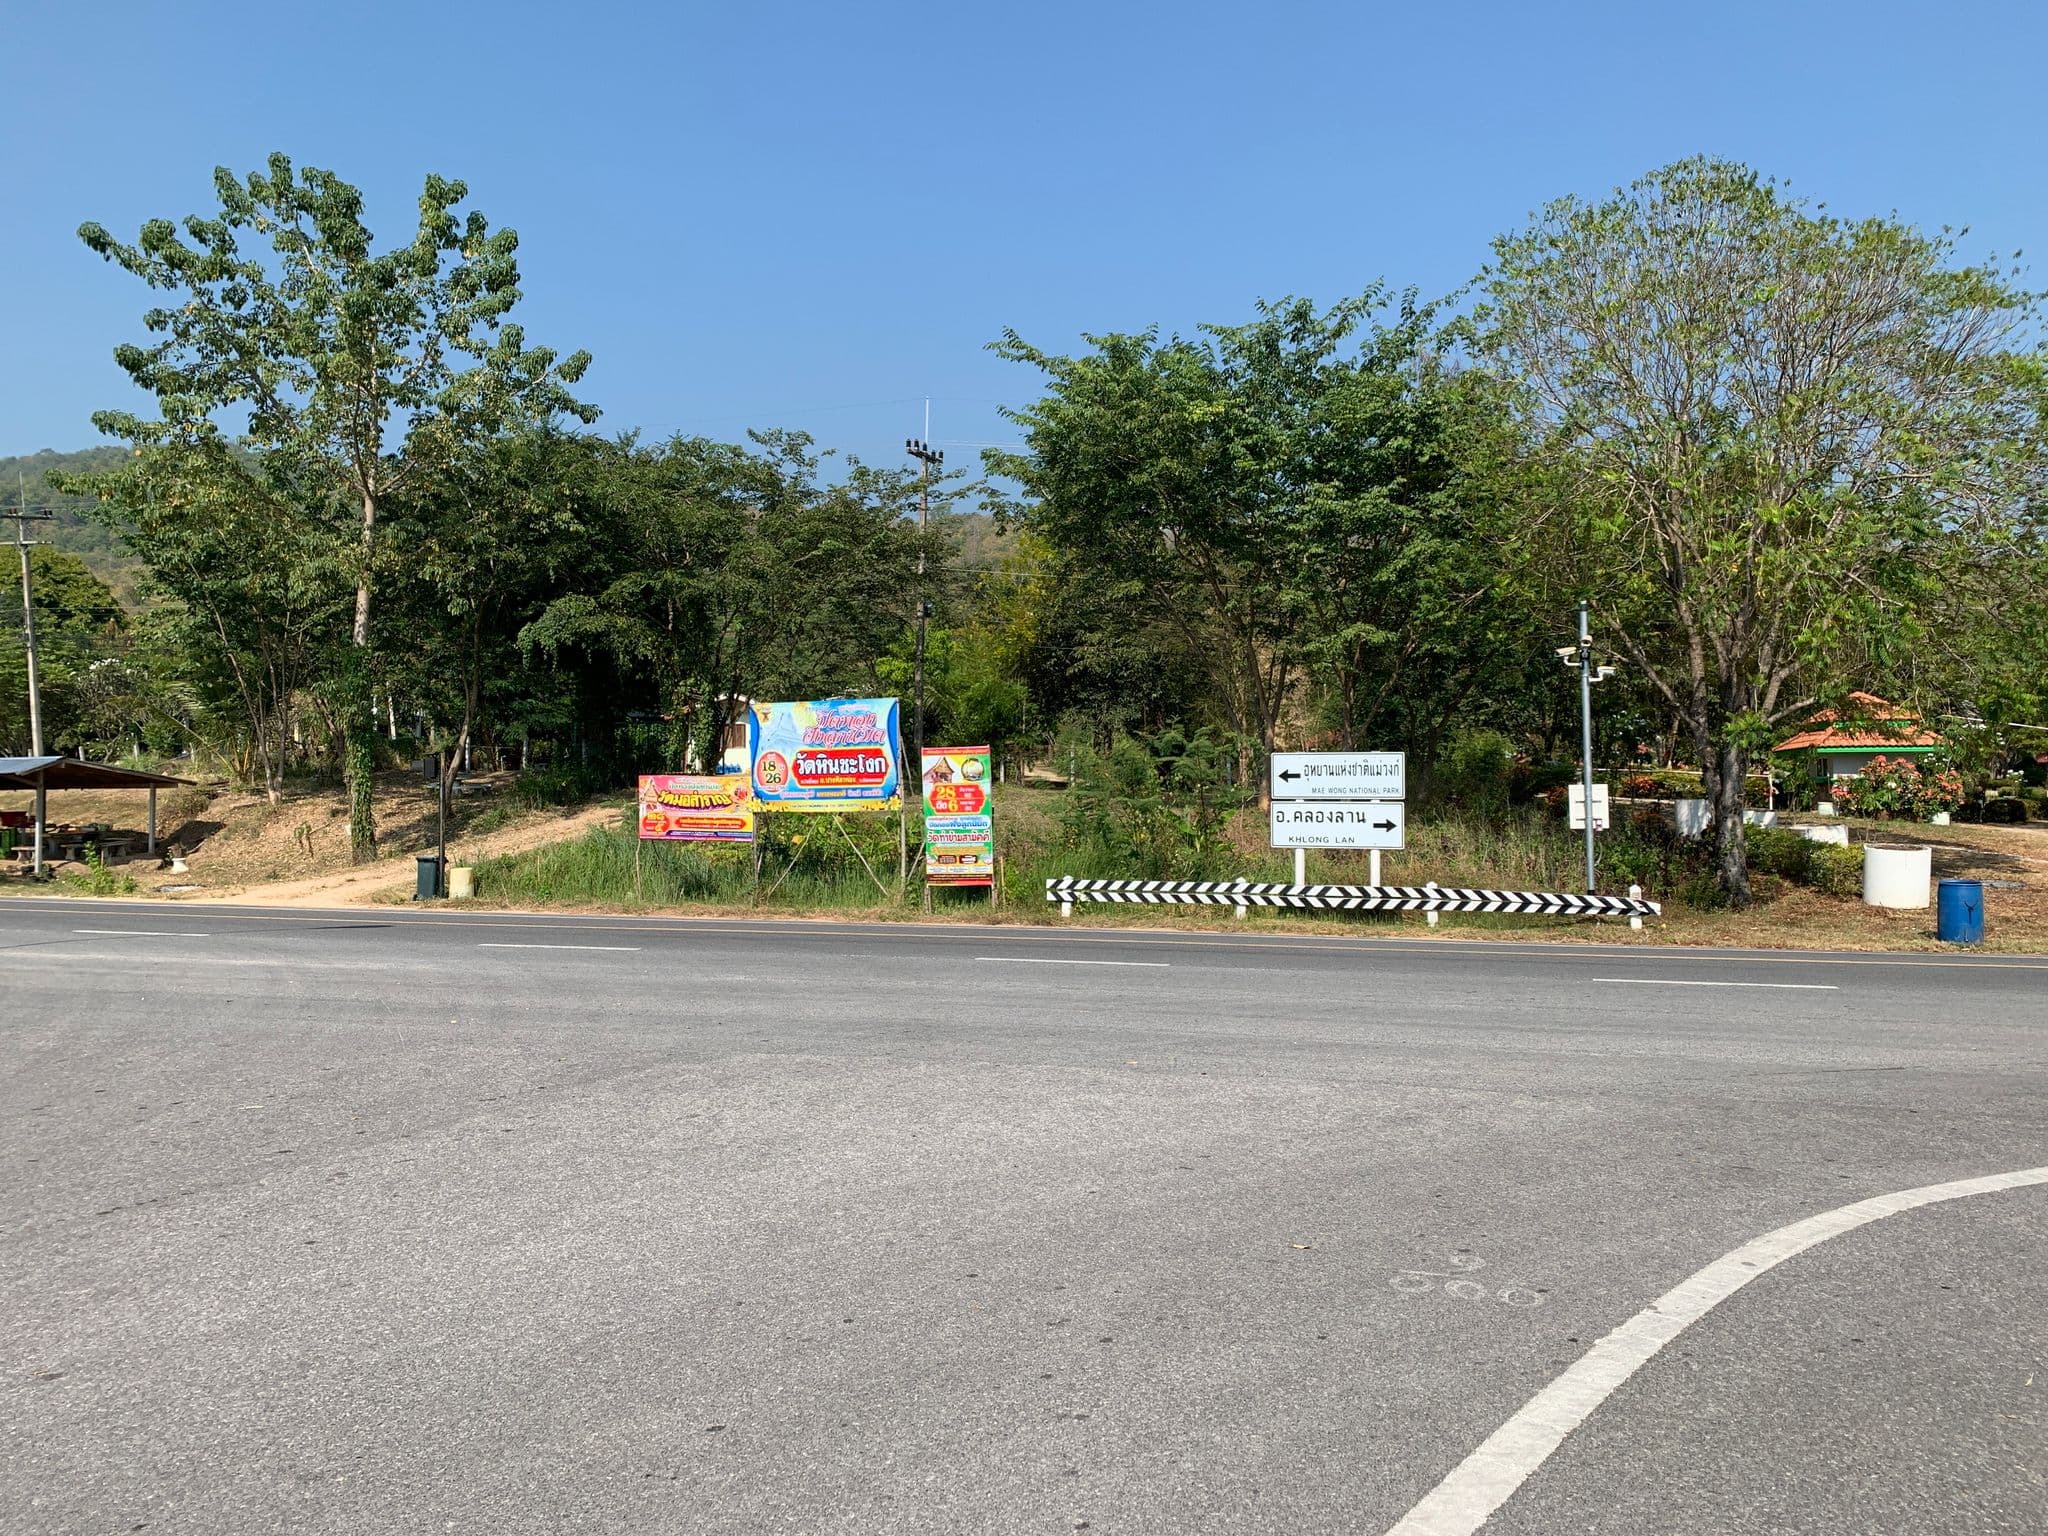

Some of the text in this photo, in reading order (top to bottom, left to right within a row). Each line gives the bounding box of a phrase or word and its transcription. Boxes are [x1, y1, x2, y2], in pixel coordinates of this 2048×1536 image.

[762, 760, 776, 772] 18
[796, 752, 886, 775] วัดหินชะโงก
[1304, 759, 1400, 781] อุทยานแห่งชาติแม่วงก์
[765, 772, 781, 784] 26
[935, 785, 957, 801] 28
[948, 800, 959, 812] 6
[1288, 836, 1355, 844] KHLONG LAN
